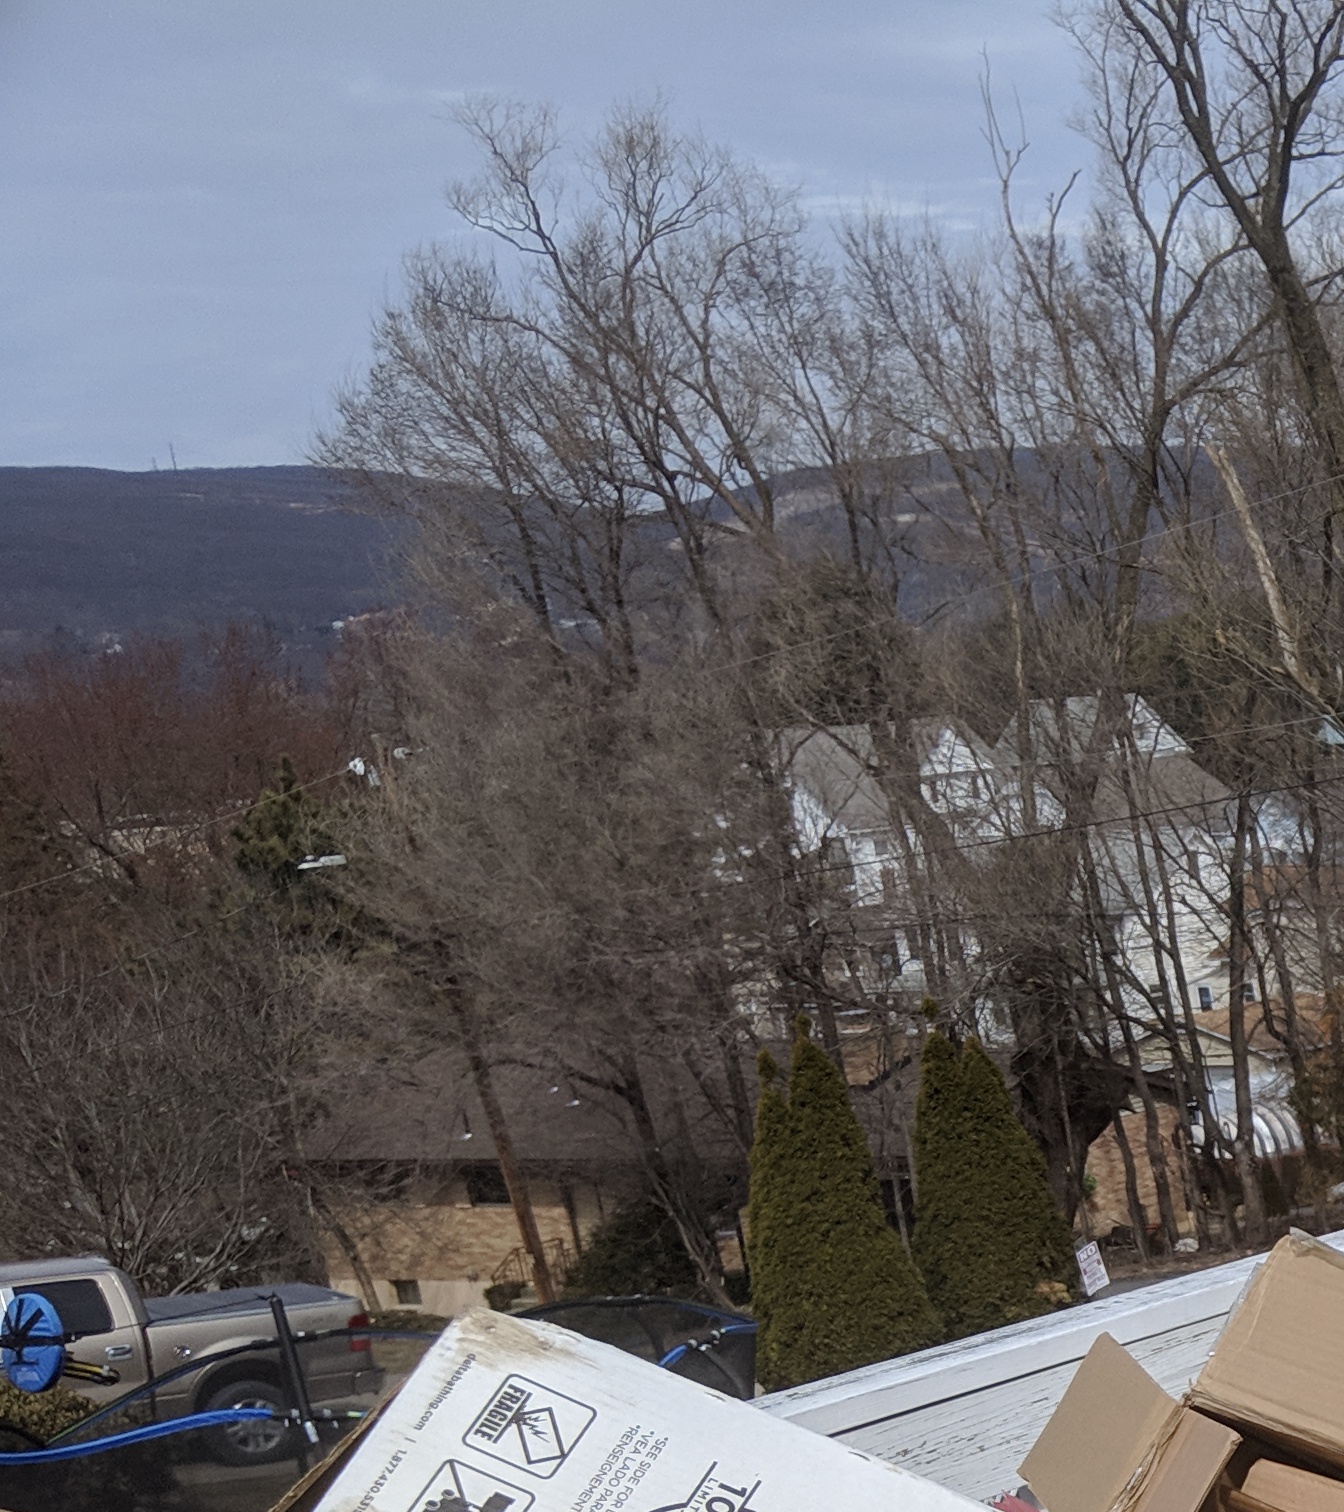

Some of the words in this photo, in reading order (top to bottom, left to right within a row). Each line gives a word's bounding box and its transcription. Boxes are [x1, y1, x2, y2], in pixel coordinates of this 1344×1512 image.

[414, 1352, 478, 1431] deltabathing.com
[471, 1382, 528, 1442] FRAGILE
[608, 1456, 637, 1488] LADO
[627, 1460, 652, 1486] SIDE
[609, 1484, 634, 1509] FOR
